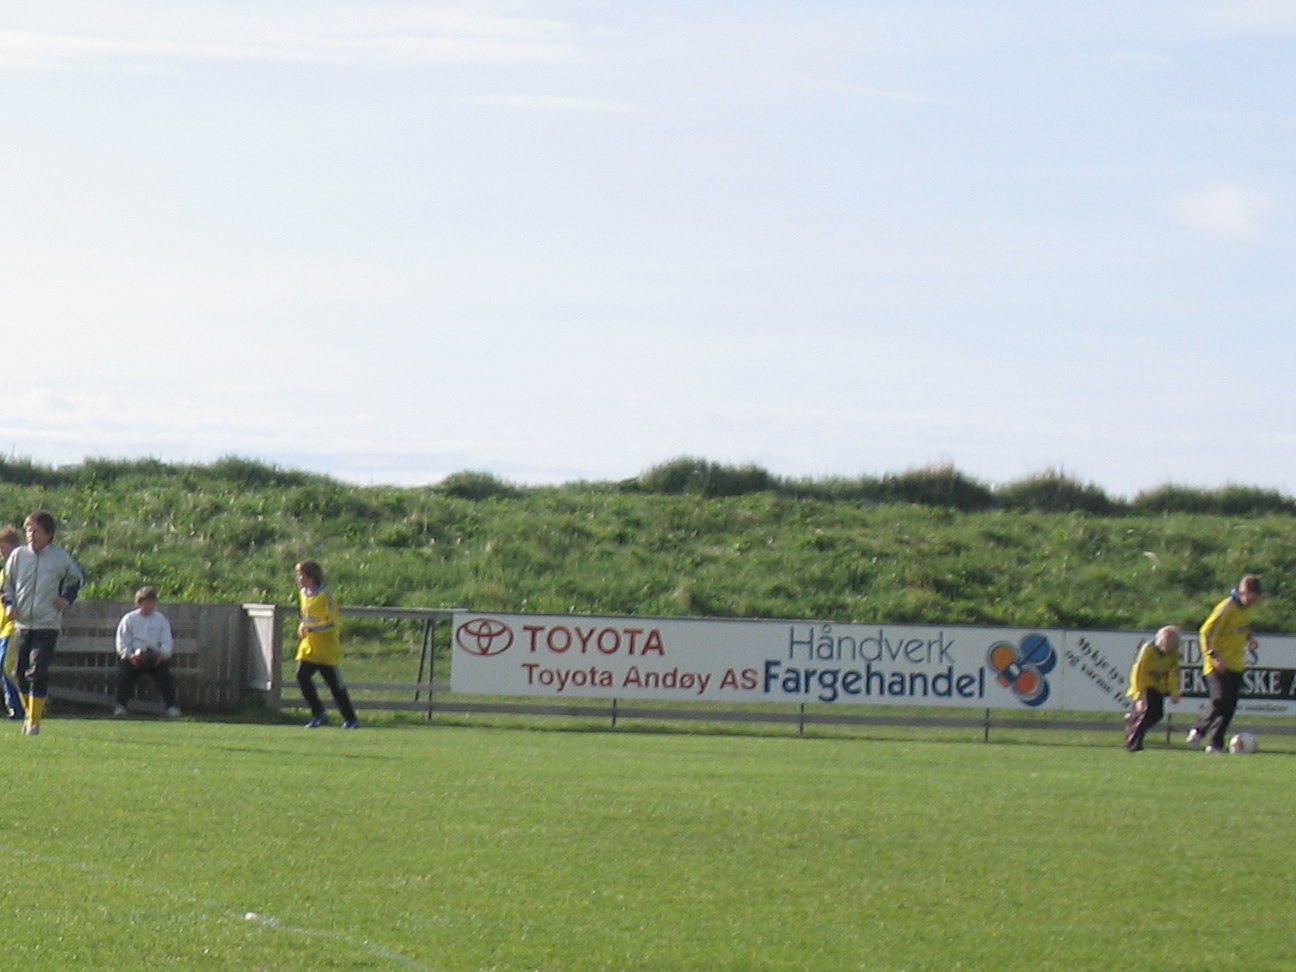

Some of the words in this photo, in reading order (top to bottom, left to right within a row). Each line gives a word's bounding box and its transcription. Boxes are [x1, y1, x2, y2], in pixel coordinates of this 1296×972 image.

[522, 624, 666, 657] TOYOTA
[788, 623, 954, 664] Håndverk
[521, 663, 614, 693] Toyota
[622, 664, 711, 695] Andøy
[718, 668, 759, 691] AS
[763, 659, 985, 703] Fargehandel
